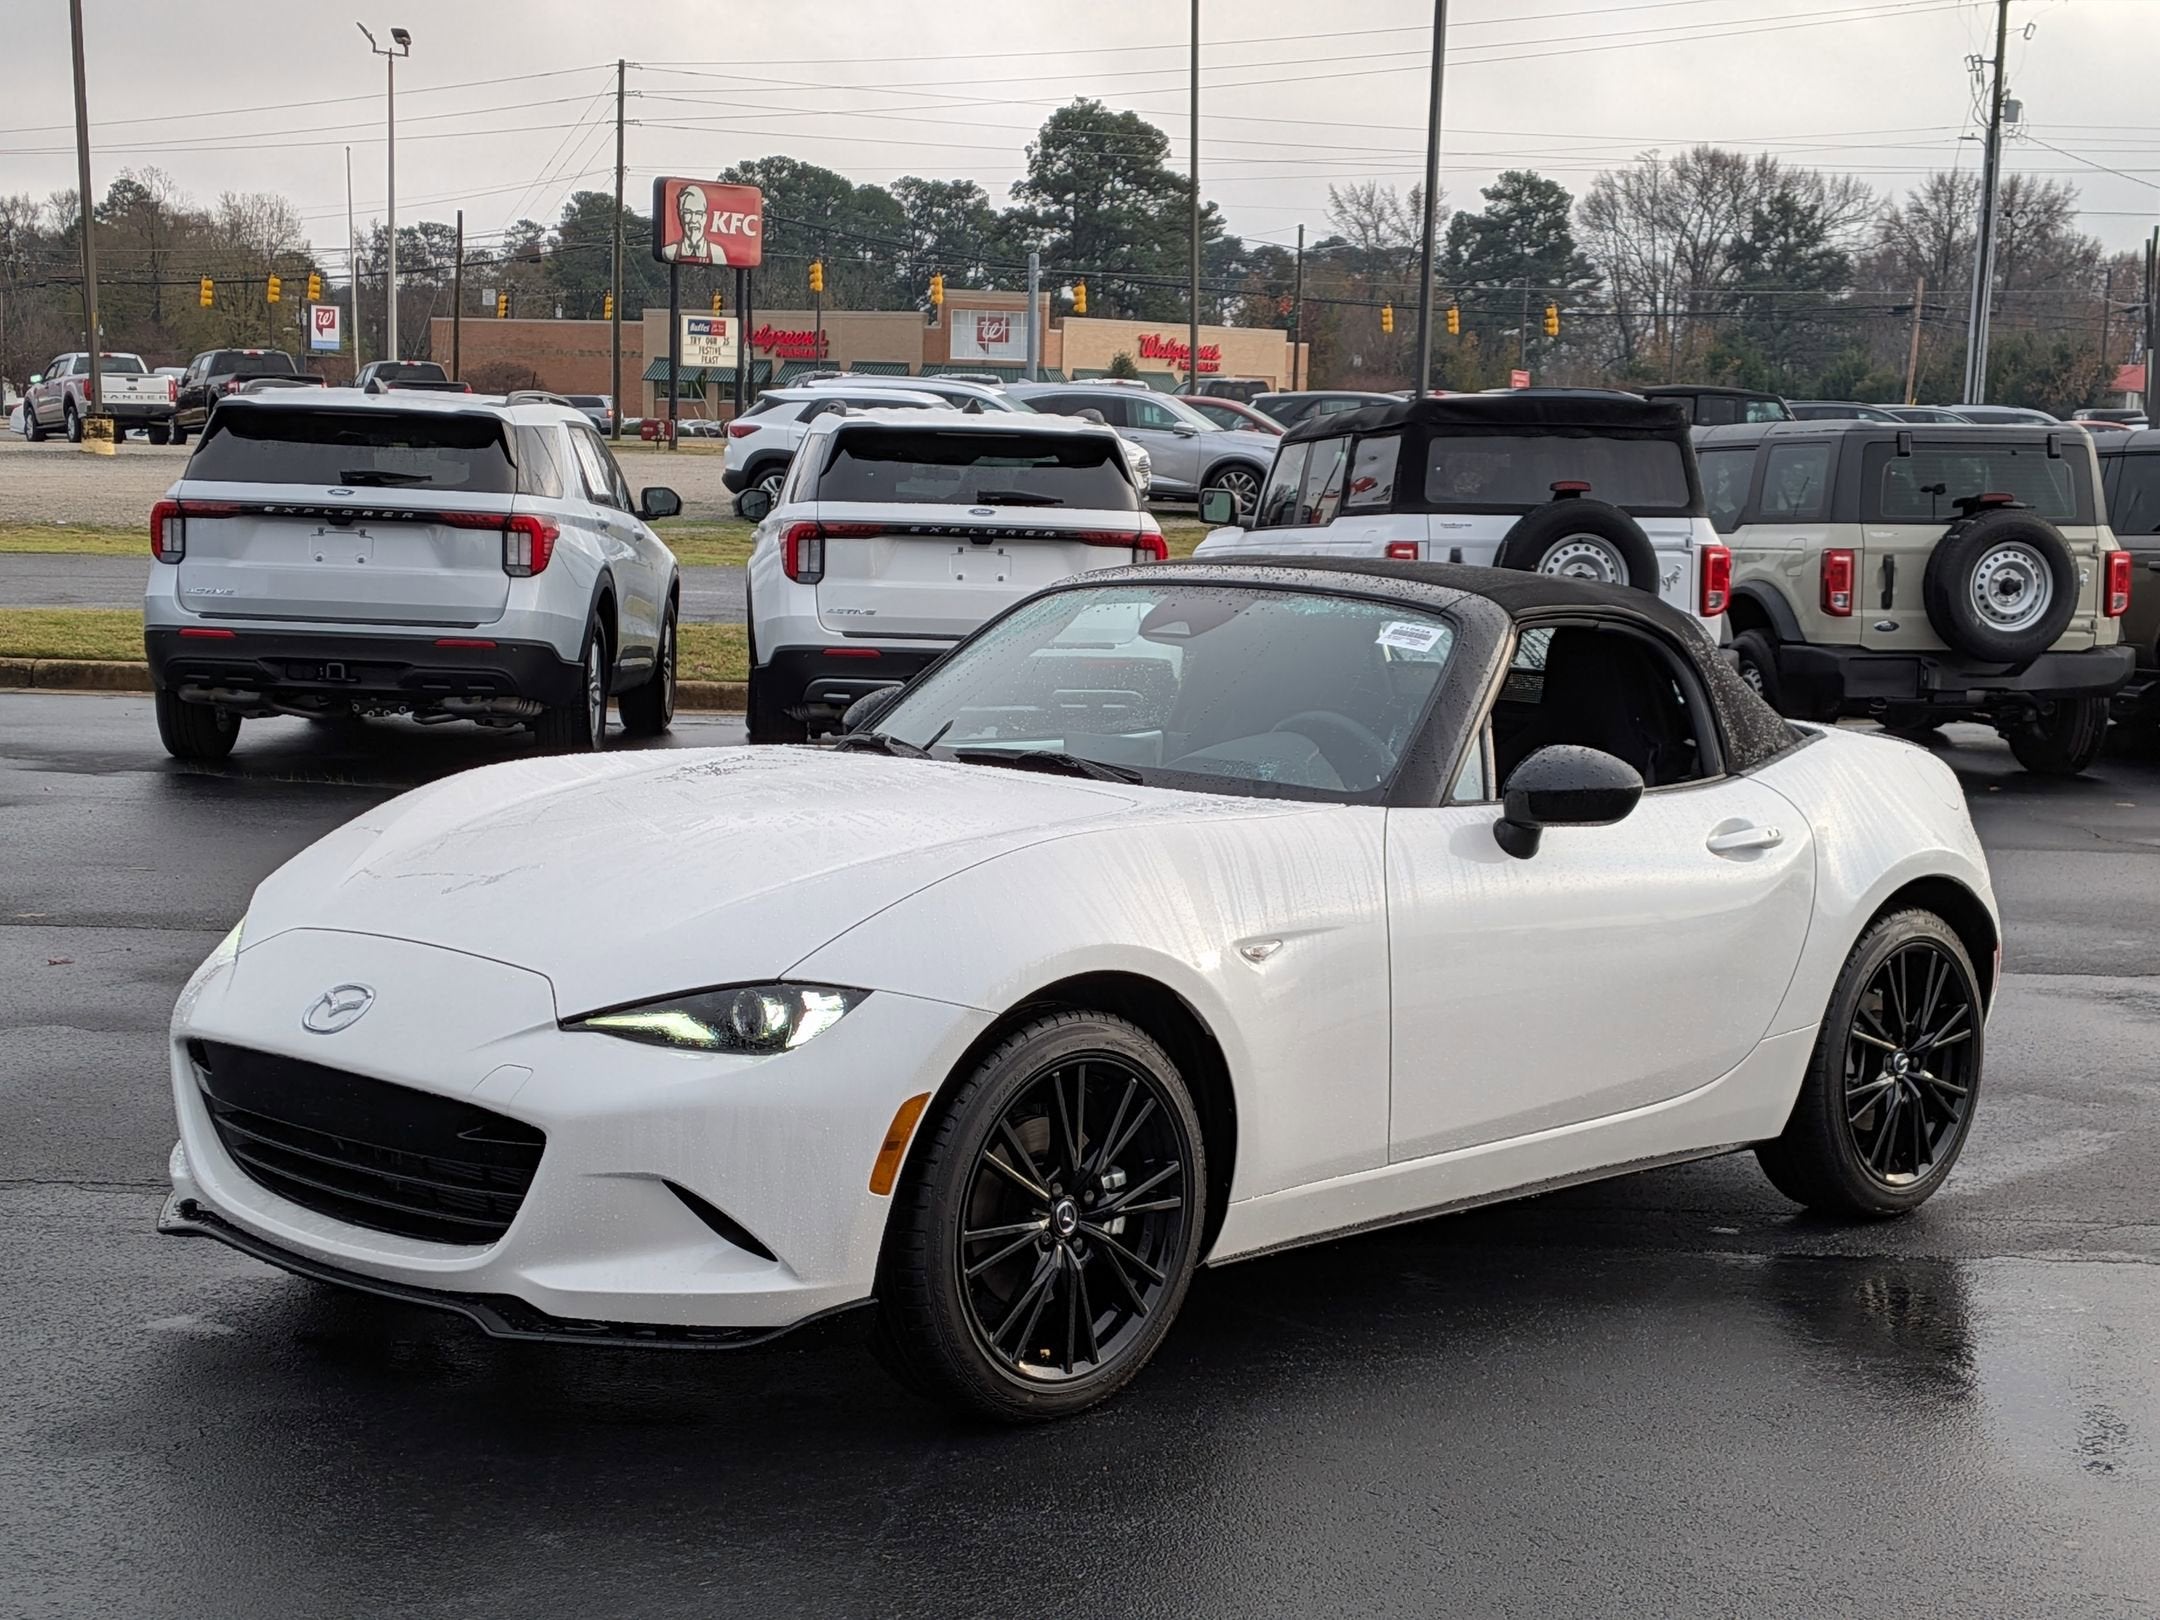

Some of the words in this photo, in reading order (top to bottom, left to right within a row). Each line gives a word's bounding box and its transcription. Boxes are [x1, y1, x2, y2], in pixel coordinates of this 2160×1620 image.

[710, 211, 759, 237] KFC
[690, 336, 701, 345] TRY
[701, 355, 719, 365] FEAST
[264, 506, 414, 518] EXPLORER
[910, 526, 1056, 537] EXPLORER
